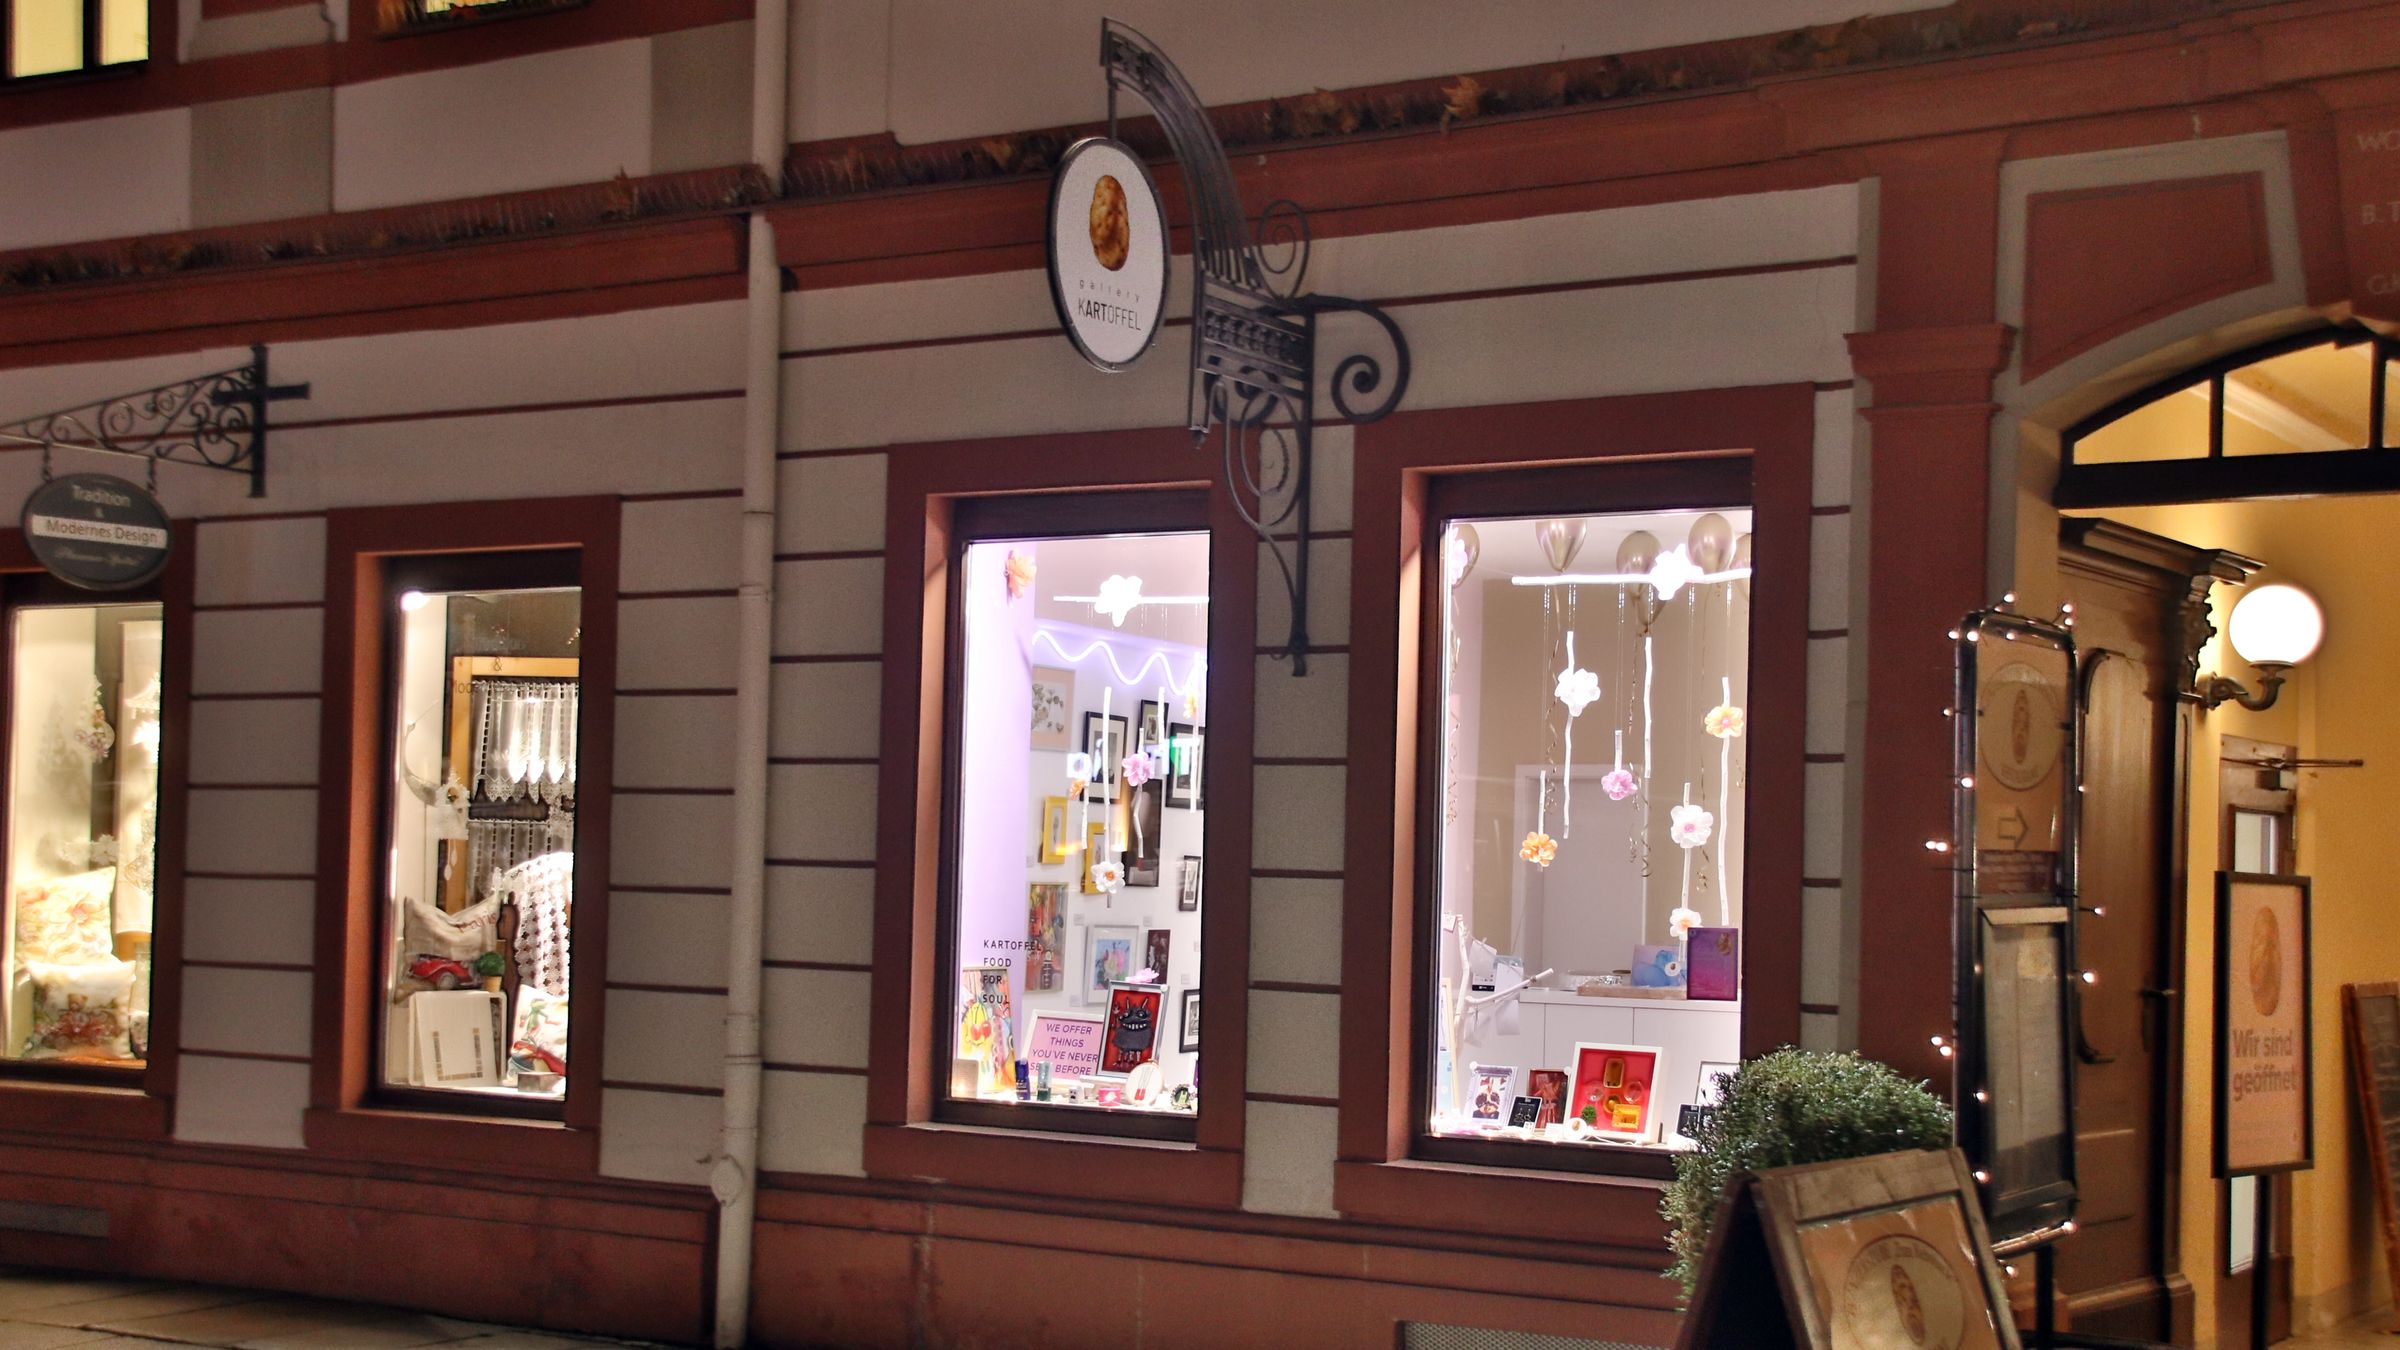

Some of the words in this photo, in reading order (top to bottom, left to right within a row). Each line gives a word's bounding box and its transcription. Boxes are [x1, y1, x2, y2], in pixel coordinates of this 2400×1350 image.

[1078, 298, 1142, 331] KARTOFFEL
[72, 484, 131, 508] Tradition
[47, 519, 113, 539] Modernes
[115, 526, 158, 546] Design
[493, 656, 503, 672] &
[983, 939, 1042, 951] KARTOFFEL
[983, 957, 1012, 968] FOOD
[982, 974, 1003, 985] FOR
[982, 994, 1010, 1005] SOUL
[1046, 1023, 1060, 1033] WE
[1062, 1024, 1093, 1035] OFFER
[1050, 1036, 1085, 1048] THINGS
[2233, 1027, 2261, 1058] Wir
[2263, 1026, 2292, 1057] sind
[1032, 1049, 1066, 1060] YOU'VE
[1067, 1052, 1099, 1063] NEVER
[1055, 1064, 1092, 1076] BEFORE
[2232, 1063, 2297, 1103] geöffnet
